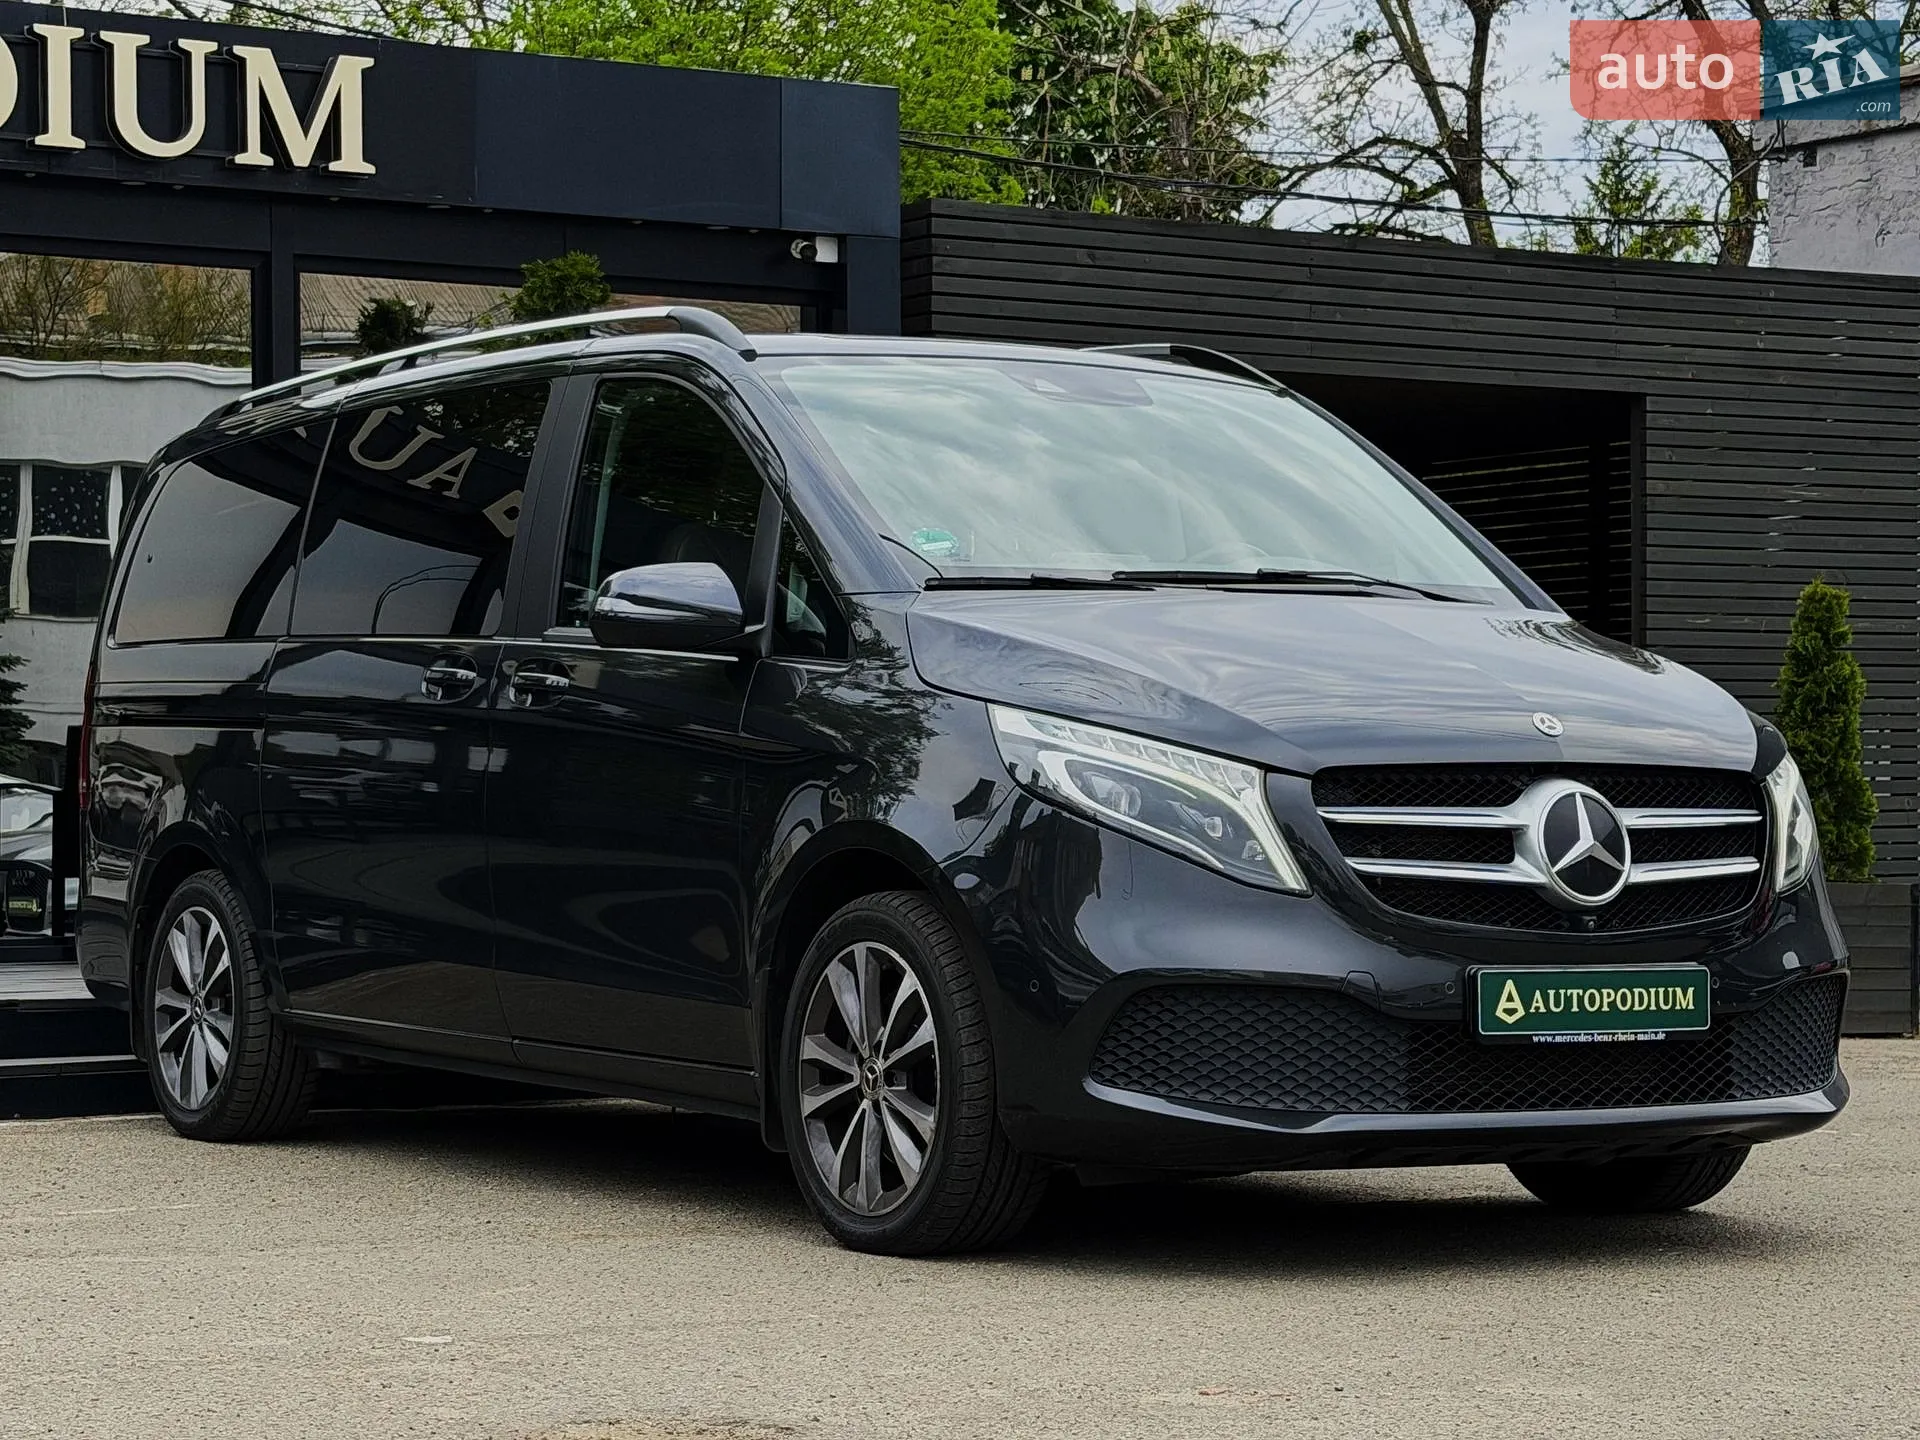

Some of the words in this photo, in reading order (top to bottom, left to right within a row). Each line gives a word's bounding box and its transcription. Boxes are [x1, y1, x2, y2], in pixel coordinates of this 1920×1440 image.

[0, 23, 376, 175] IUM
[1529, 986, 1695, 1013] AUTOPODIUM
[1532, 1032, 1666, 1043] www.mercedes-benz-rhein-main.de
